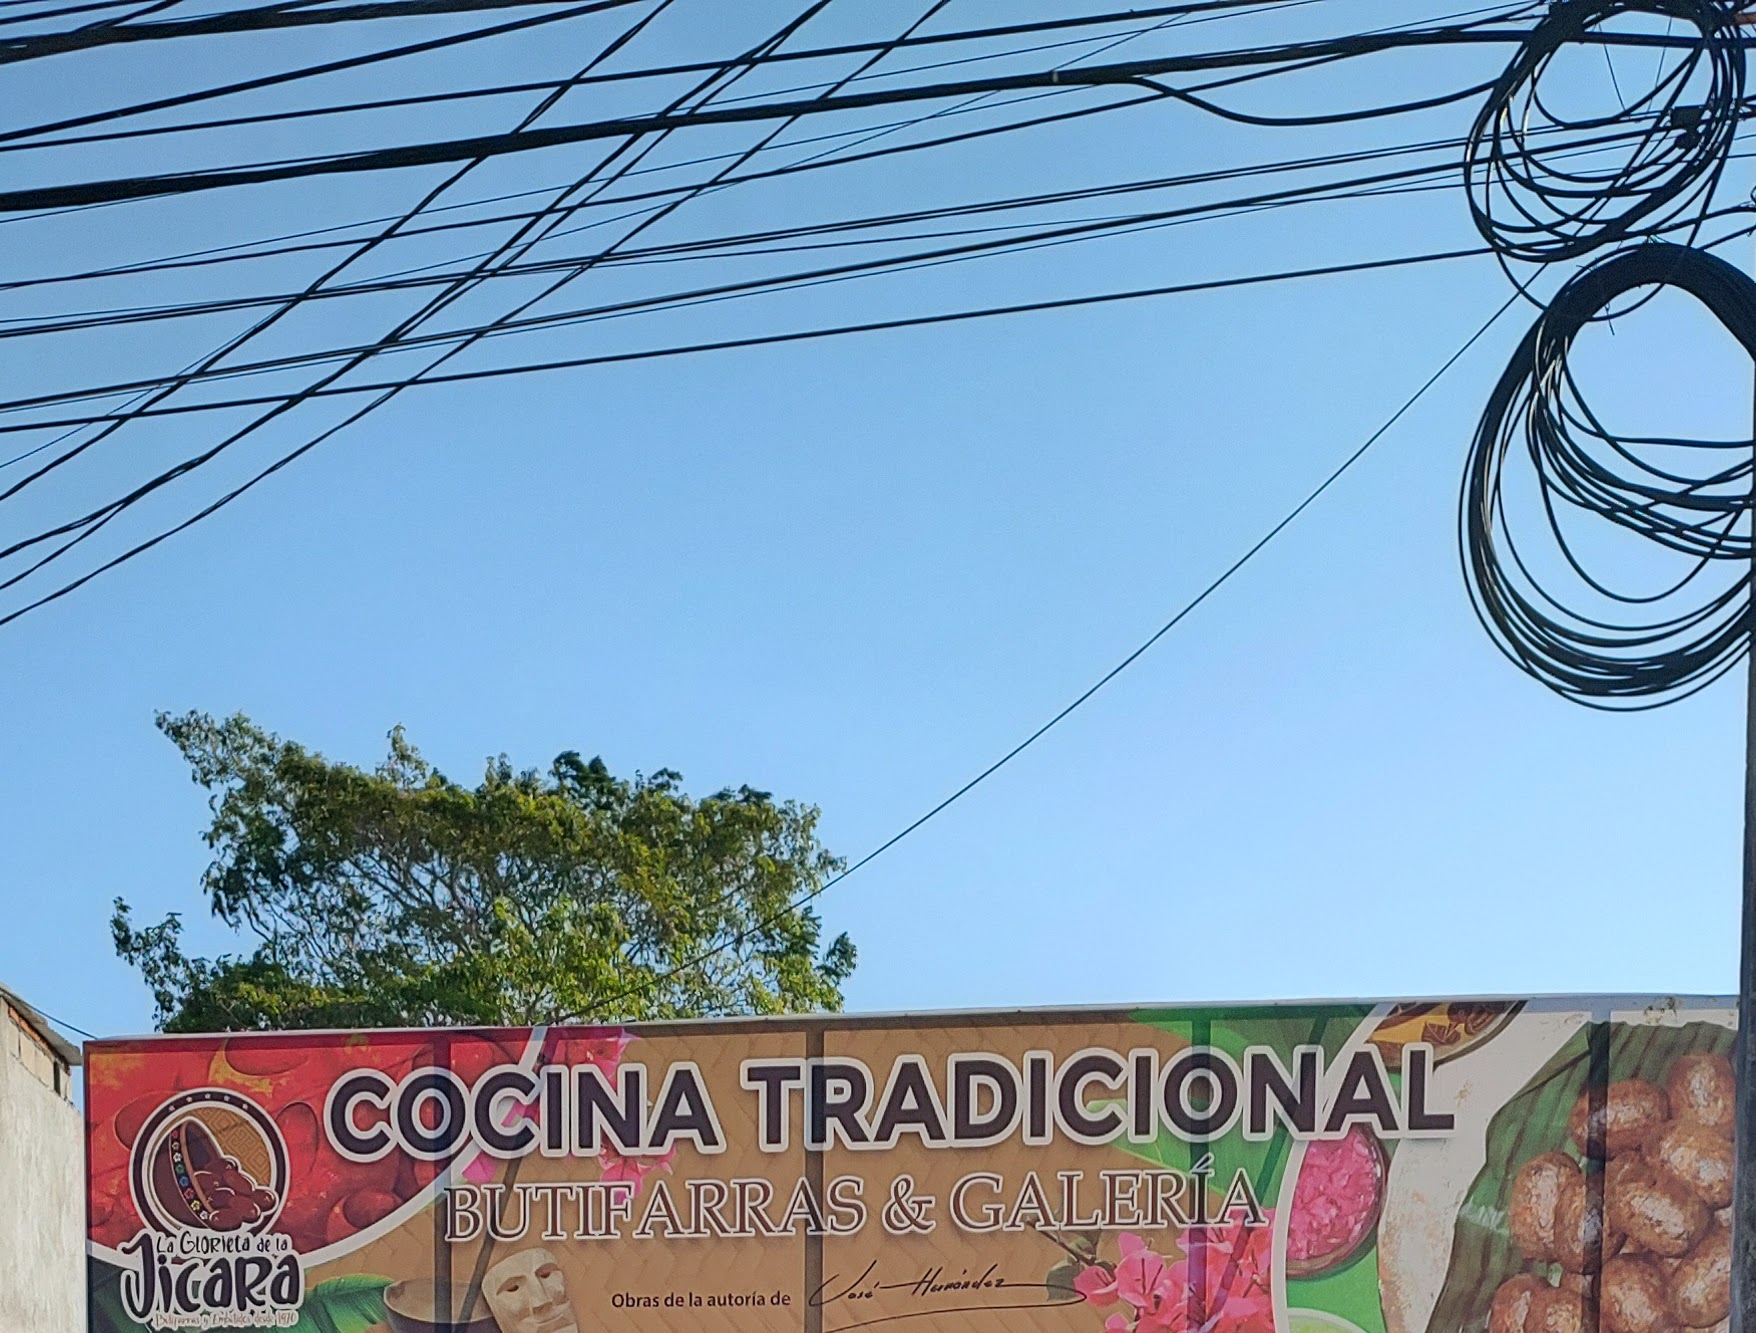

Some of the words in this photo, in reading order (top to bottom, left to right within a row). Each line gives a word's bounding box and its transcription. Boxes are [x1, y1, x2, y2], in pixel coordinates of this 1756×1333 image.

[325, 1061, 726, 1162] COCINA
[741, 1043, 1457, 1153] TRADICIONAL
[443, 1176, 867, 1243] BUTIFARRAS
[882, 1171, 935, 1234] &
[950, 1153, 1269, 1233] GALERÍA
[156, 1236, 174, 1253] La
[257, 1235, 271, 1252] de
[276, 1235, 288, 1251] la
[611, 1292, 660, 1308] Obras
[664, 1291, 685, 1307] de
[689, 1292, 703, 1307] la
[707, 1291, 766, 1307] autoría
[770, 1290, 791, 1306] de
